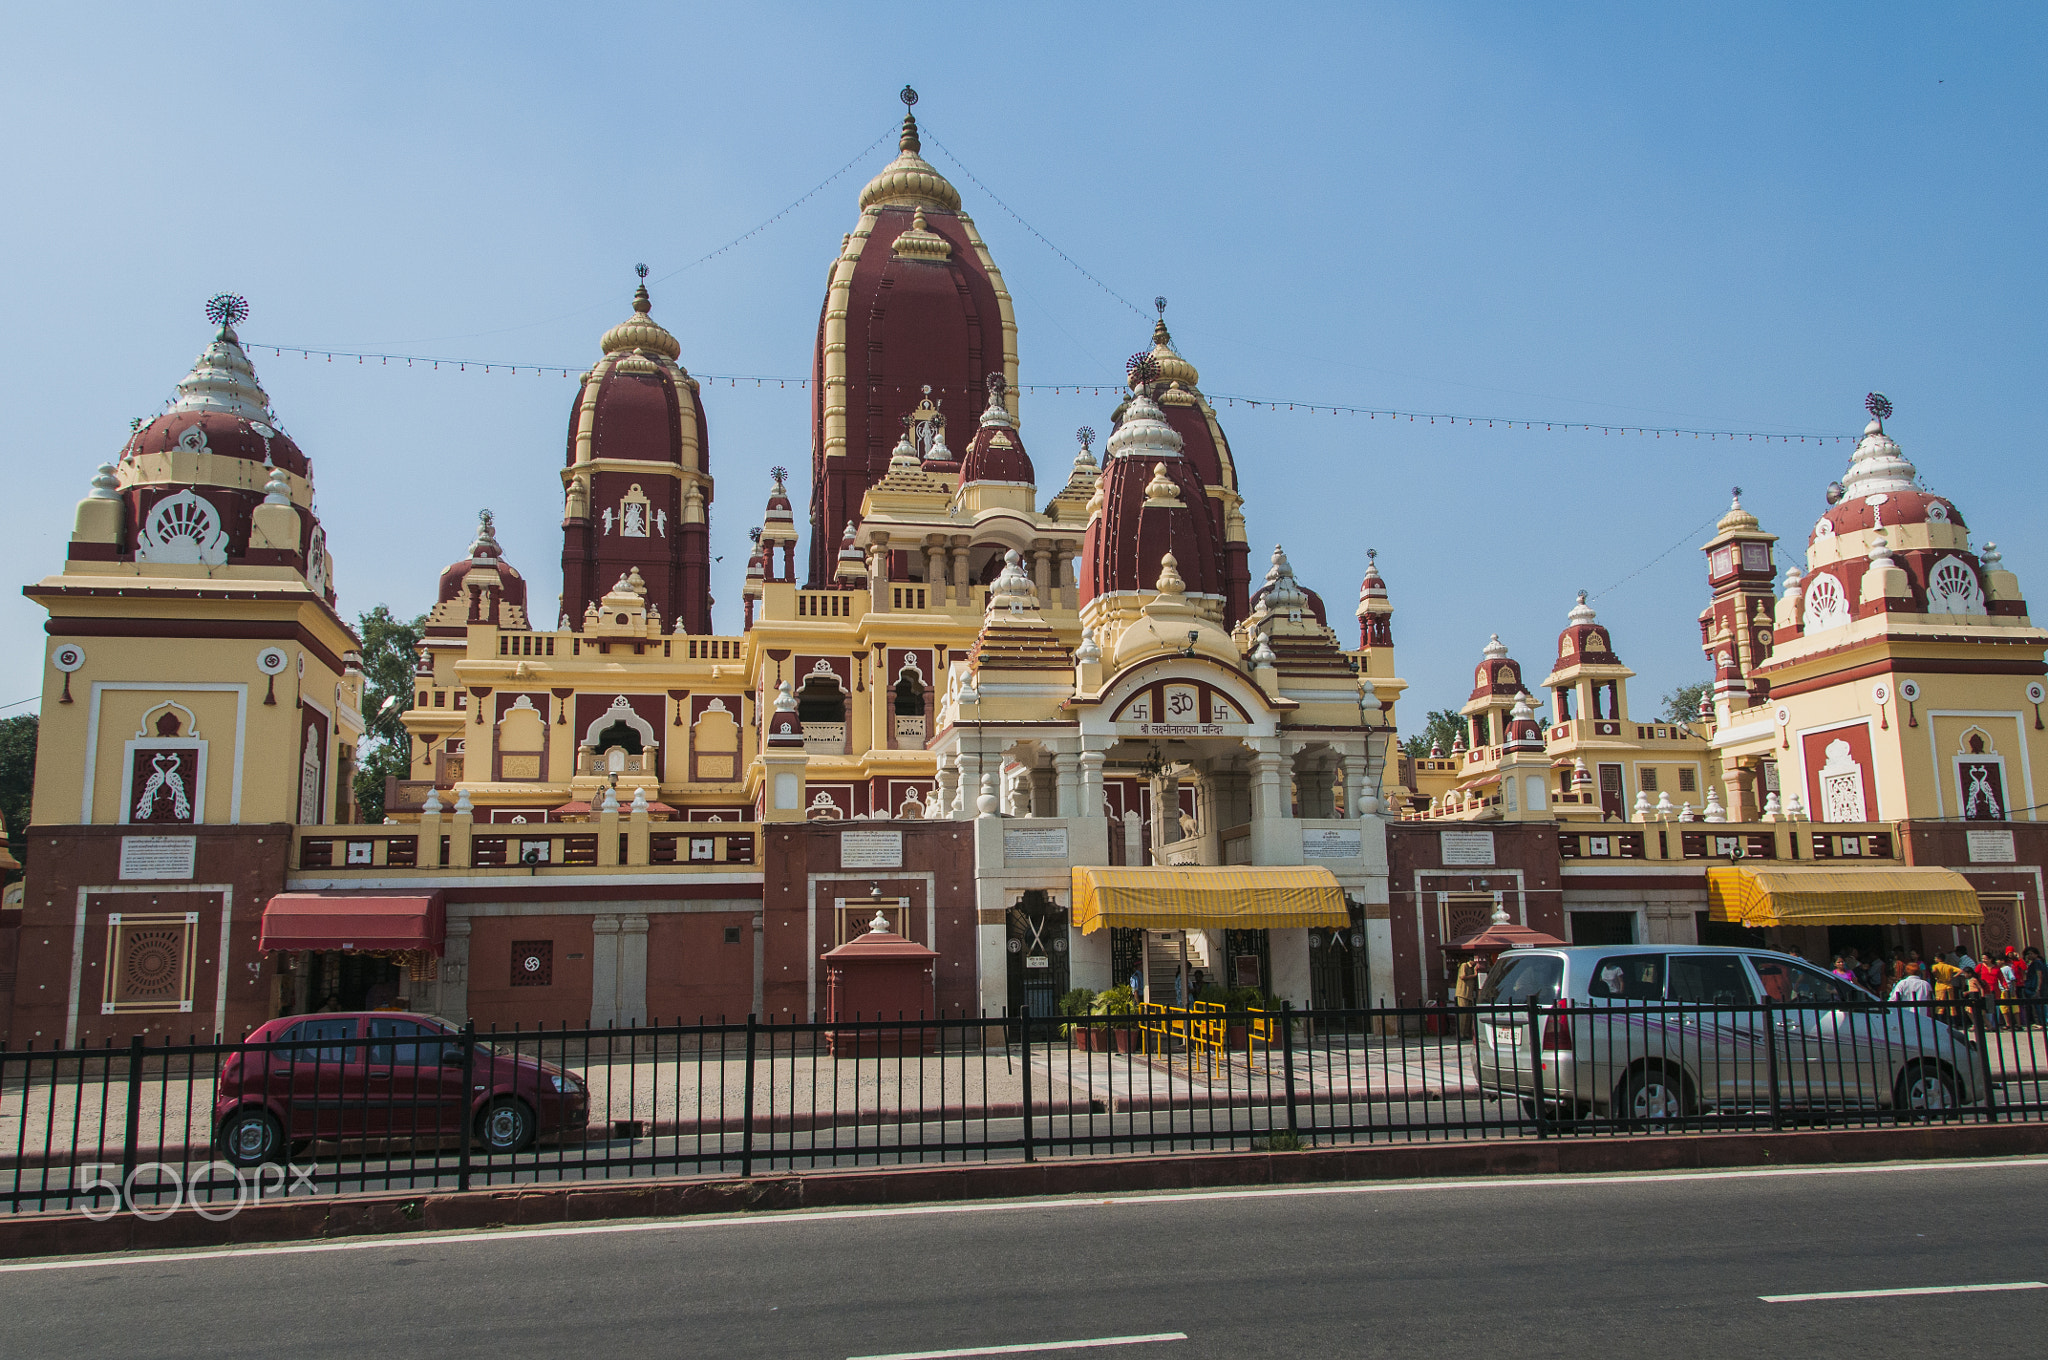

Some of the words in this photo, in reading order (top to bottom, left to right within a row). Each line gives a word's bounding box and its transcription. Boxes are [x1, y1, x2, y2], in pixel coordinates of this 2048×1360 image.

[1140, 724, 1149, 735] श्री
[1152, 724, 1199, 735] लक्ष्मीनारायण
[1202, 724, 1224, 735] मन्दिर
